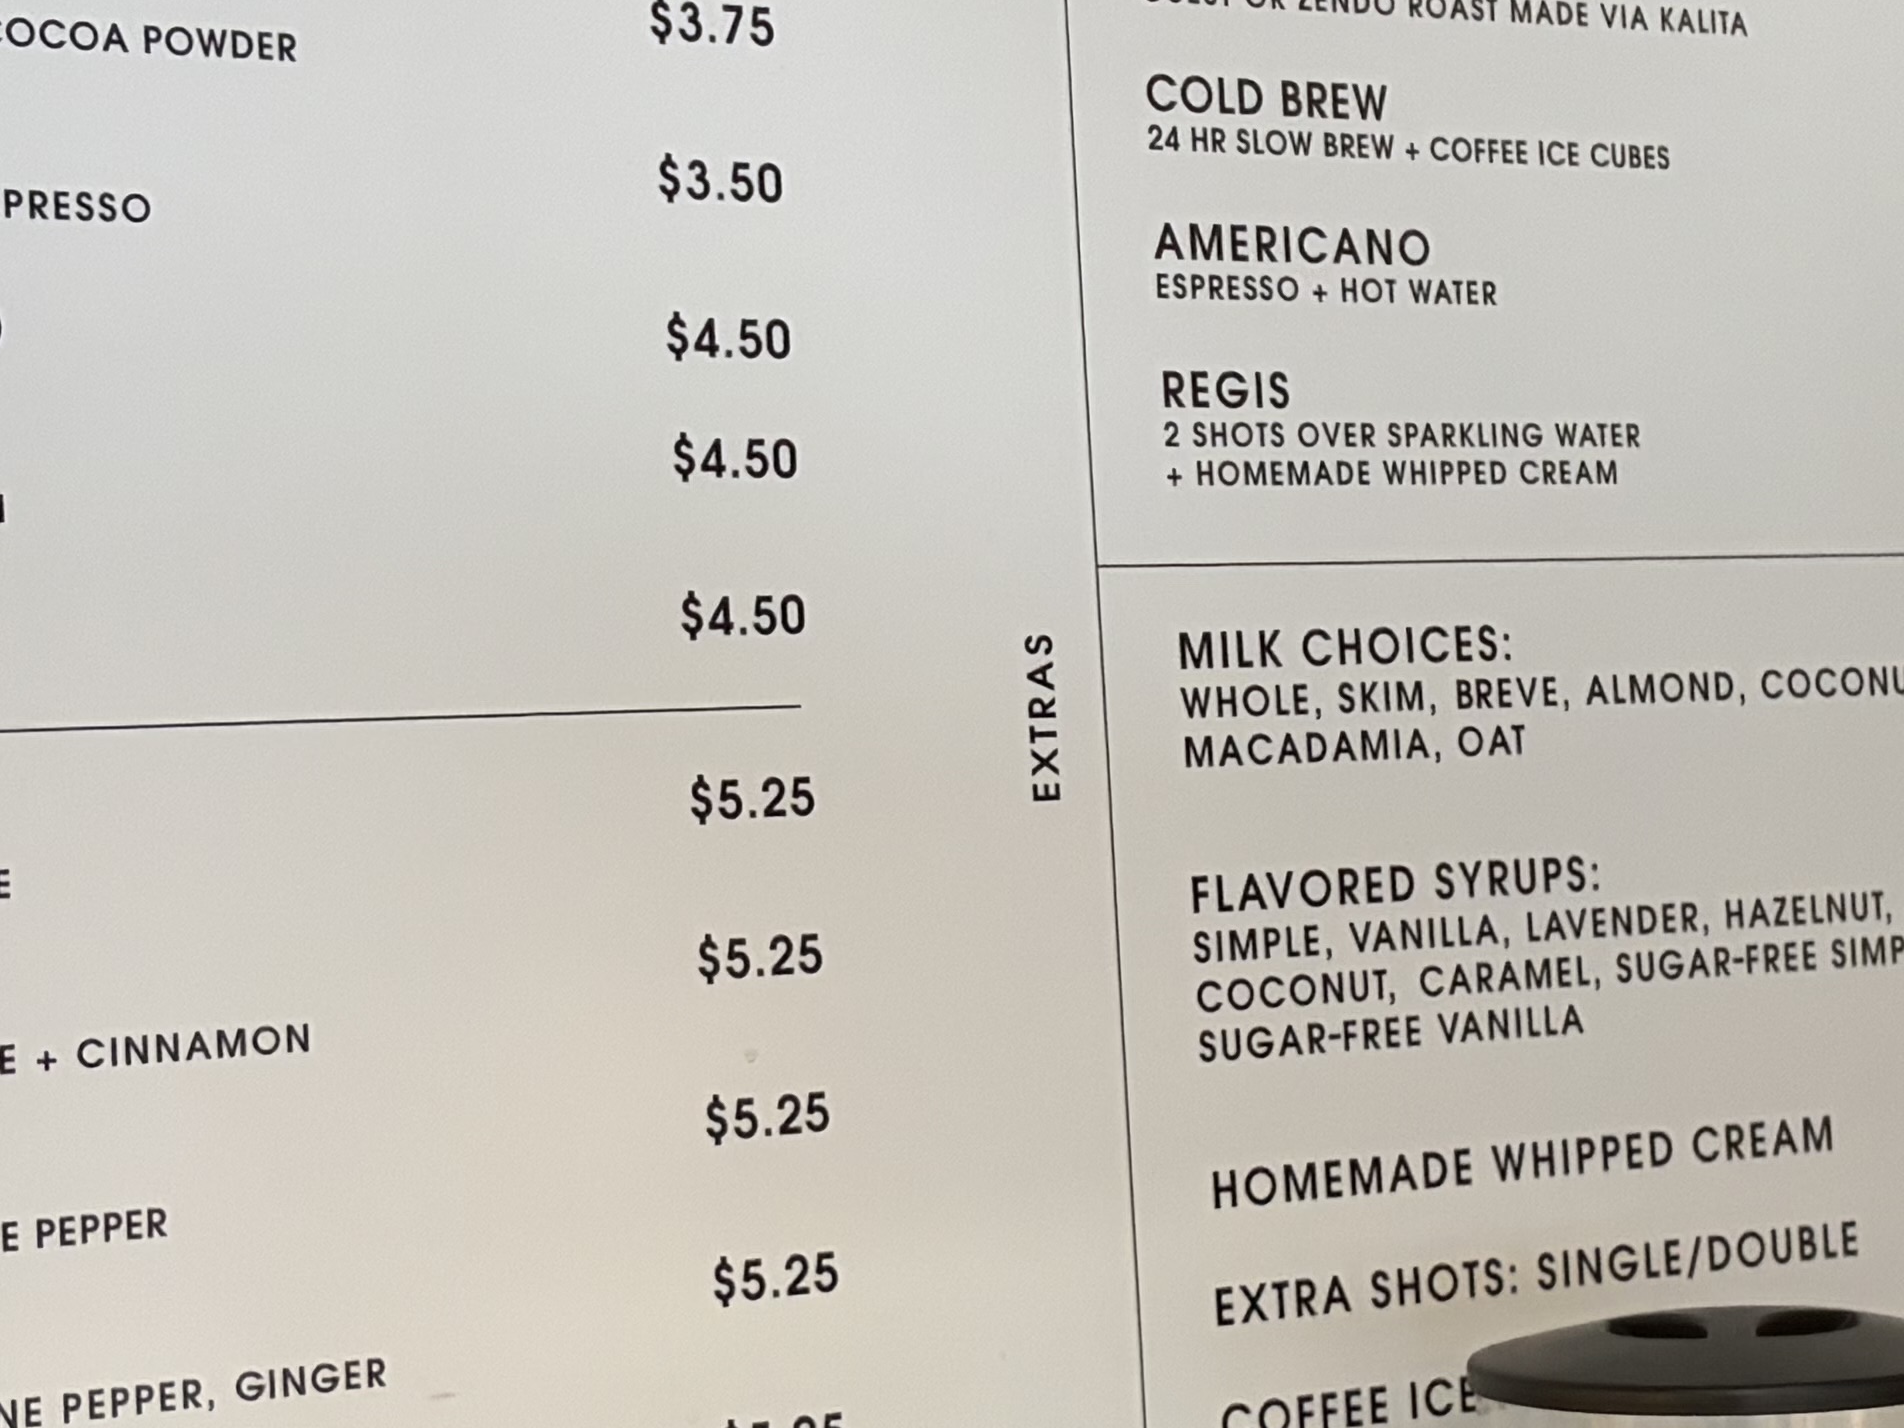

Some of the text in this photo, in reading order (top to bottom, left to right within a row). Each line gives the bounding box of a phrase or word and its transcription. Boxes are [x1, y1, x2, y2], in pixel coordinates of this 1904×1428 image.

[1598, 1, 1650, 32] VIA
[1659, 5, 1749, 39] KALITA
[657, 151, 784, 205] $3.50
[1152, 220, 1431, 268] AMERICANO
[1155, 271, 1300, 303] ESPRESSO
[1339, 276, 1398, 305] HOT
[1406, 277, 1499, 307] WATER
[665, 309, 792, 364] $4.50
[1161, 369, 1291, 411] REGIS
[1162, 419, 1642, 450] 2 SHOTS OVER SPARKLING WATER
[679, 588, 807, 643] $4.50
[1177, 623, 1513, 671] MILK CHOICES:
[1022, 633, 1063, 803] EXTRAS
[1178, 682, 1323, 722] WHOLE,
[1336, 679, 1438, 718] SKIM,
[1454, 674, 1571, 713] BREVE,
[1584, 669, 1748, 707] ALMOND,
[1183, 722, 1527, 770] MACADAMIA, OAT
[689, 772, 817, 827] $5.25
[1189, 853, 1601, 916] FLAVORED SYRUPS:
[1197, 1002, 1586, 1065] SUGAR-FREE VANILLA
[704, 1089, 831, 1148] $5.25
[1213, 1219, 1860, 1328] EXTRA SHOTS: SINGLE/DOUBLE
[1409, 1376, 1478, 1422] ICE
